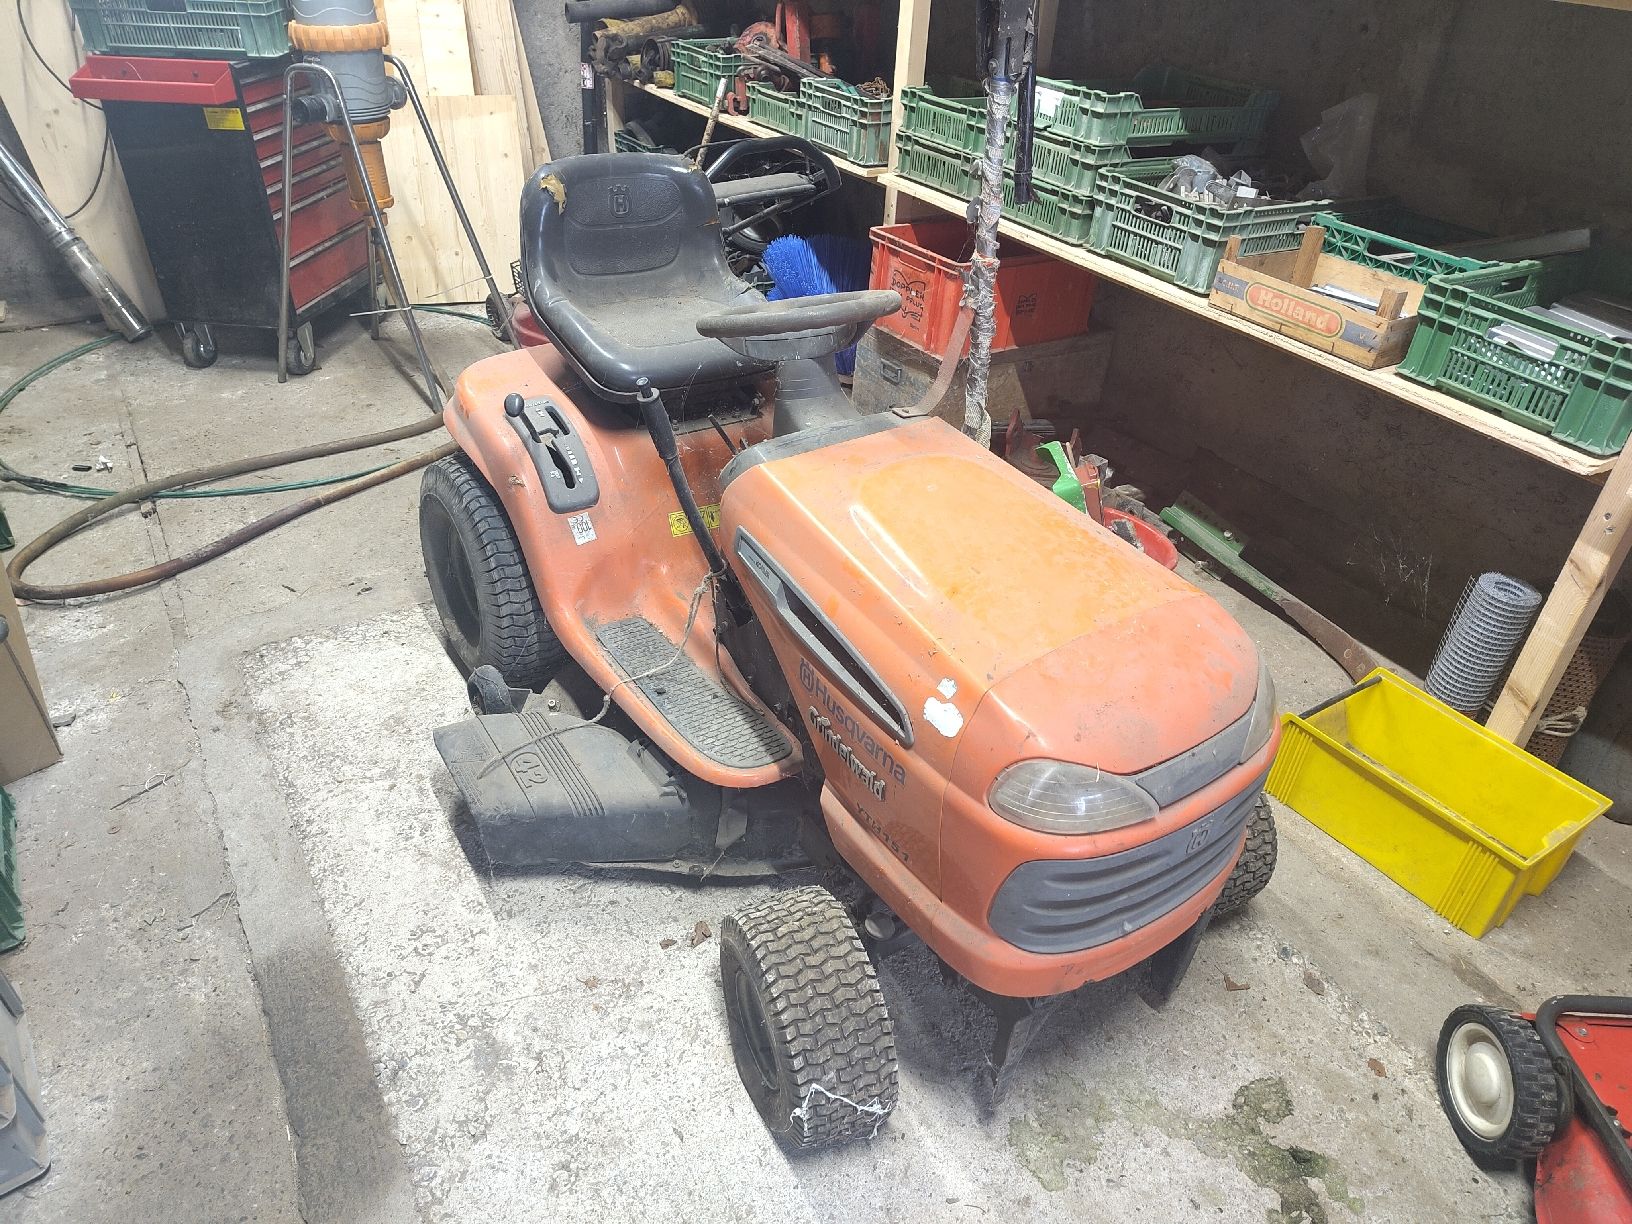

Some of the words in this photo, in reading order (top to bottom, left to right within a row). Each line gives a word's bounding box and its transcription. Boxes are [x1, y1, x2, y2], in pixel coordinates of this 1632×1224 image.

[1256, 289, 1331, 331] Holland
[808, 705, 886, 801] Grindelwald
[815, 676, 906, 786] Husqvarna
